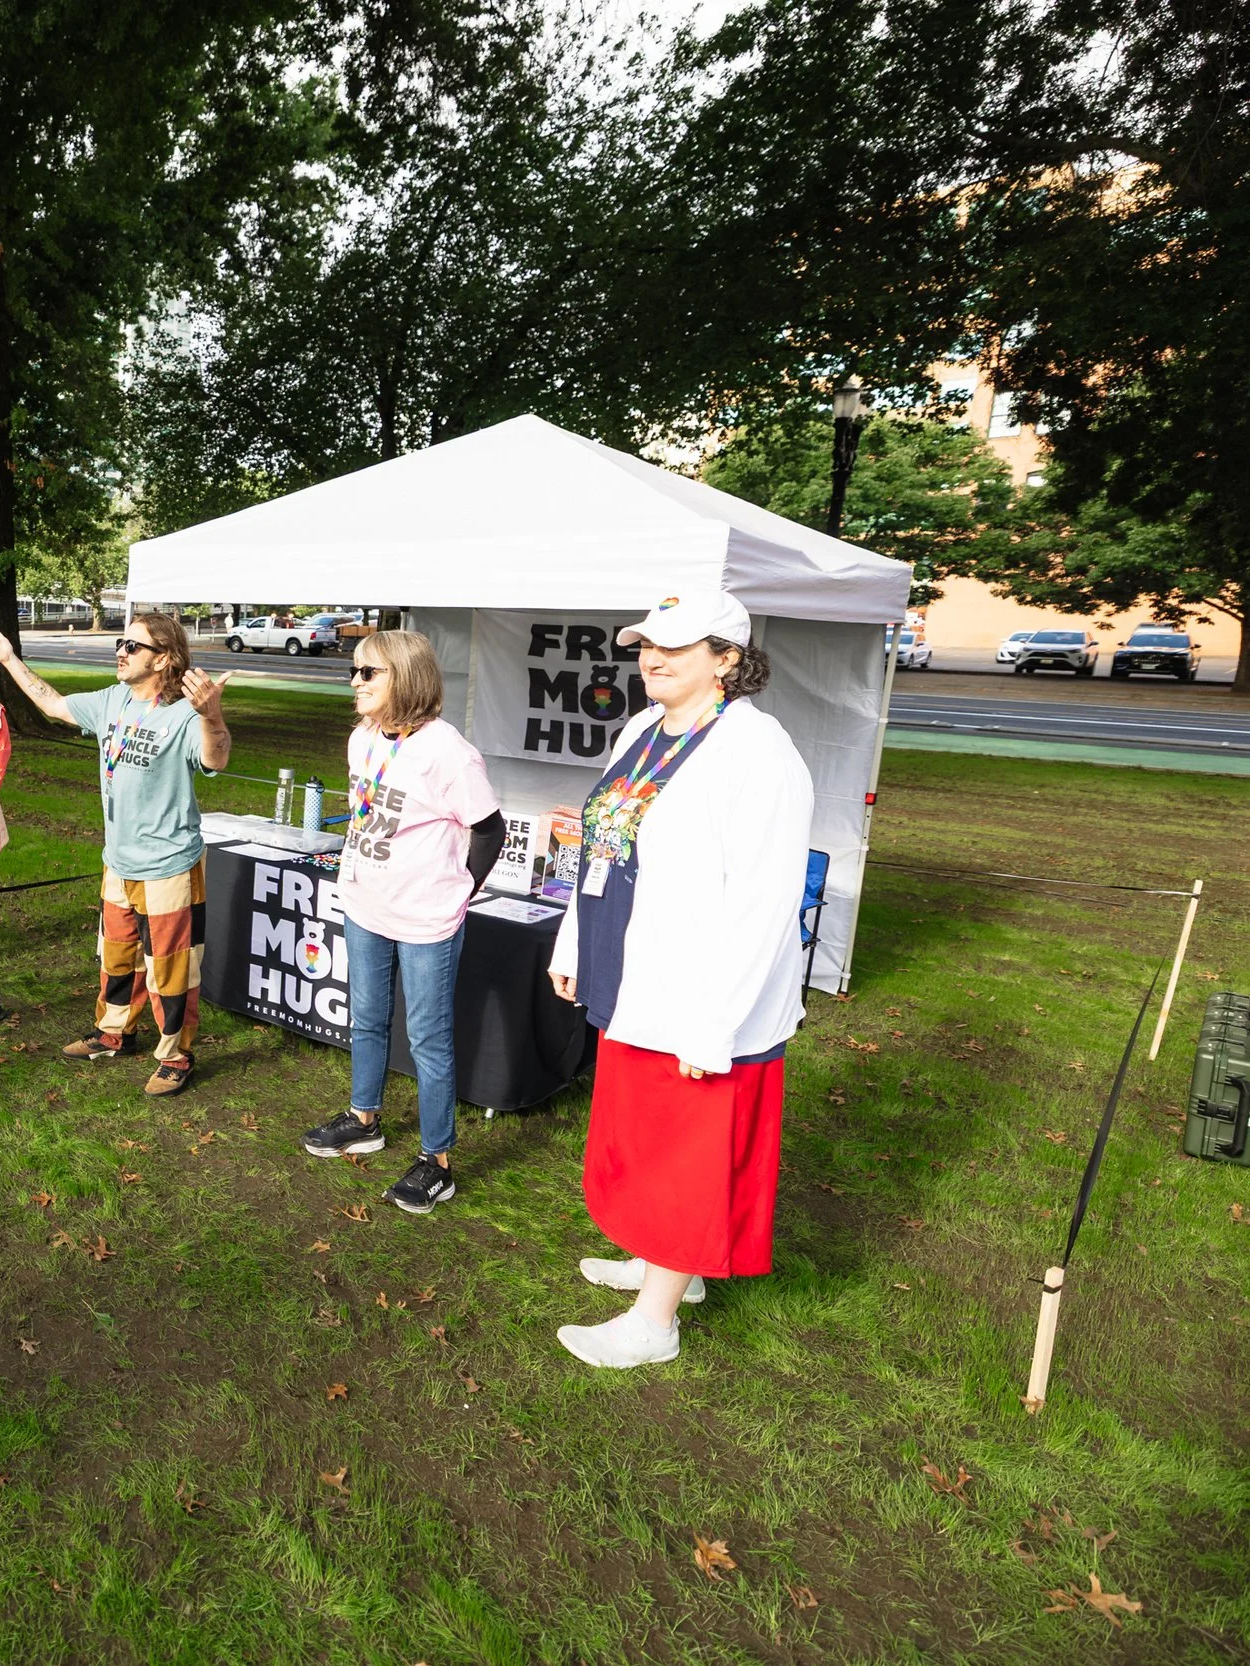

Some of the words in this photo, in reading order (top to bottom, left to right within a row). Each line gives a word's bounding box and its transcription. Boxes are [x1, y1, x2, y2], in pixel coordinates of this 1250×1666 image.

[127, 739, 160, 757] NCLE
[498, 849, 527, 864] UGS
[248, 963, 354, 1027] HUG
[426, 1179, 444, 1199] HOKA
